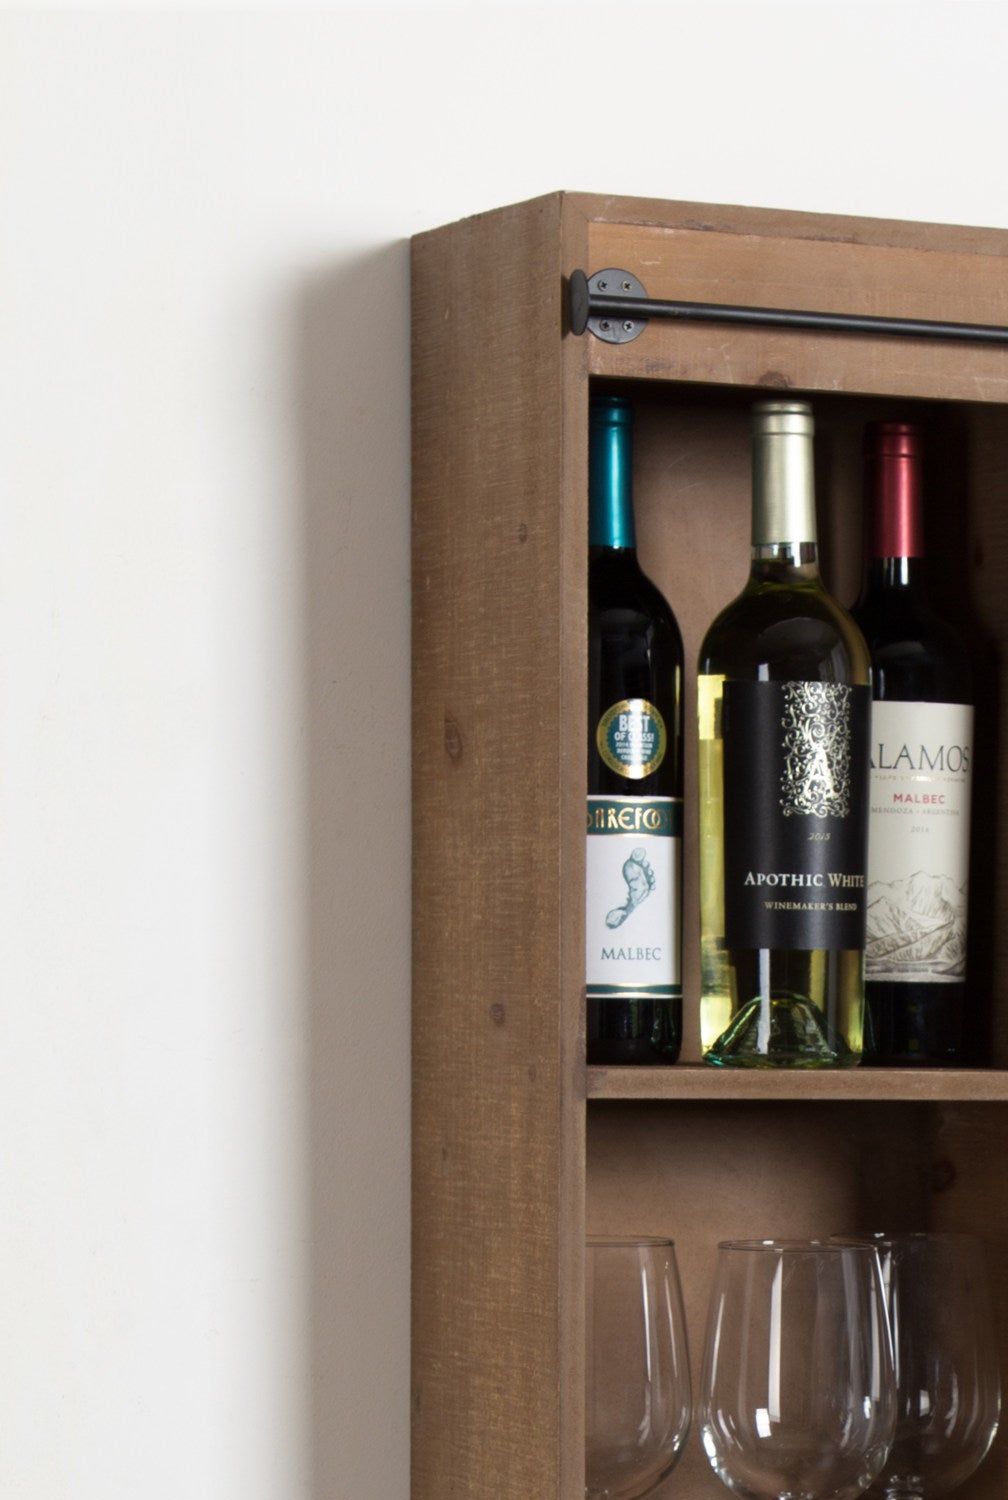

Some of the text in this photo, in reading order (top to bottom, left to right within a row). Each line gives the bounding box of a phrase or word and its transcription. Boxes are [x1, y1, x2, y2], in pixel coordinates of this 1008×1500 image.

[619, 714, 651, 733] BET
[614, 732, 655, 743] OF CSS!
[893, 793, 946, 805] MALBEC
[586, 806, 675, 831] AREFOO
[744, 871, 865, 888] APOTHIC WHITE
[764, 901, 858, 911] WINEMAKER'S BLEND
[600, 946, 662, 961] MALBEC
